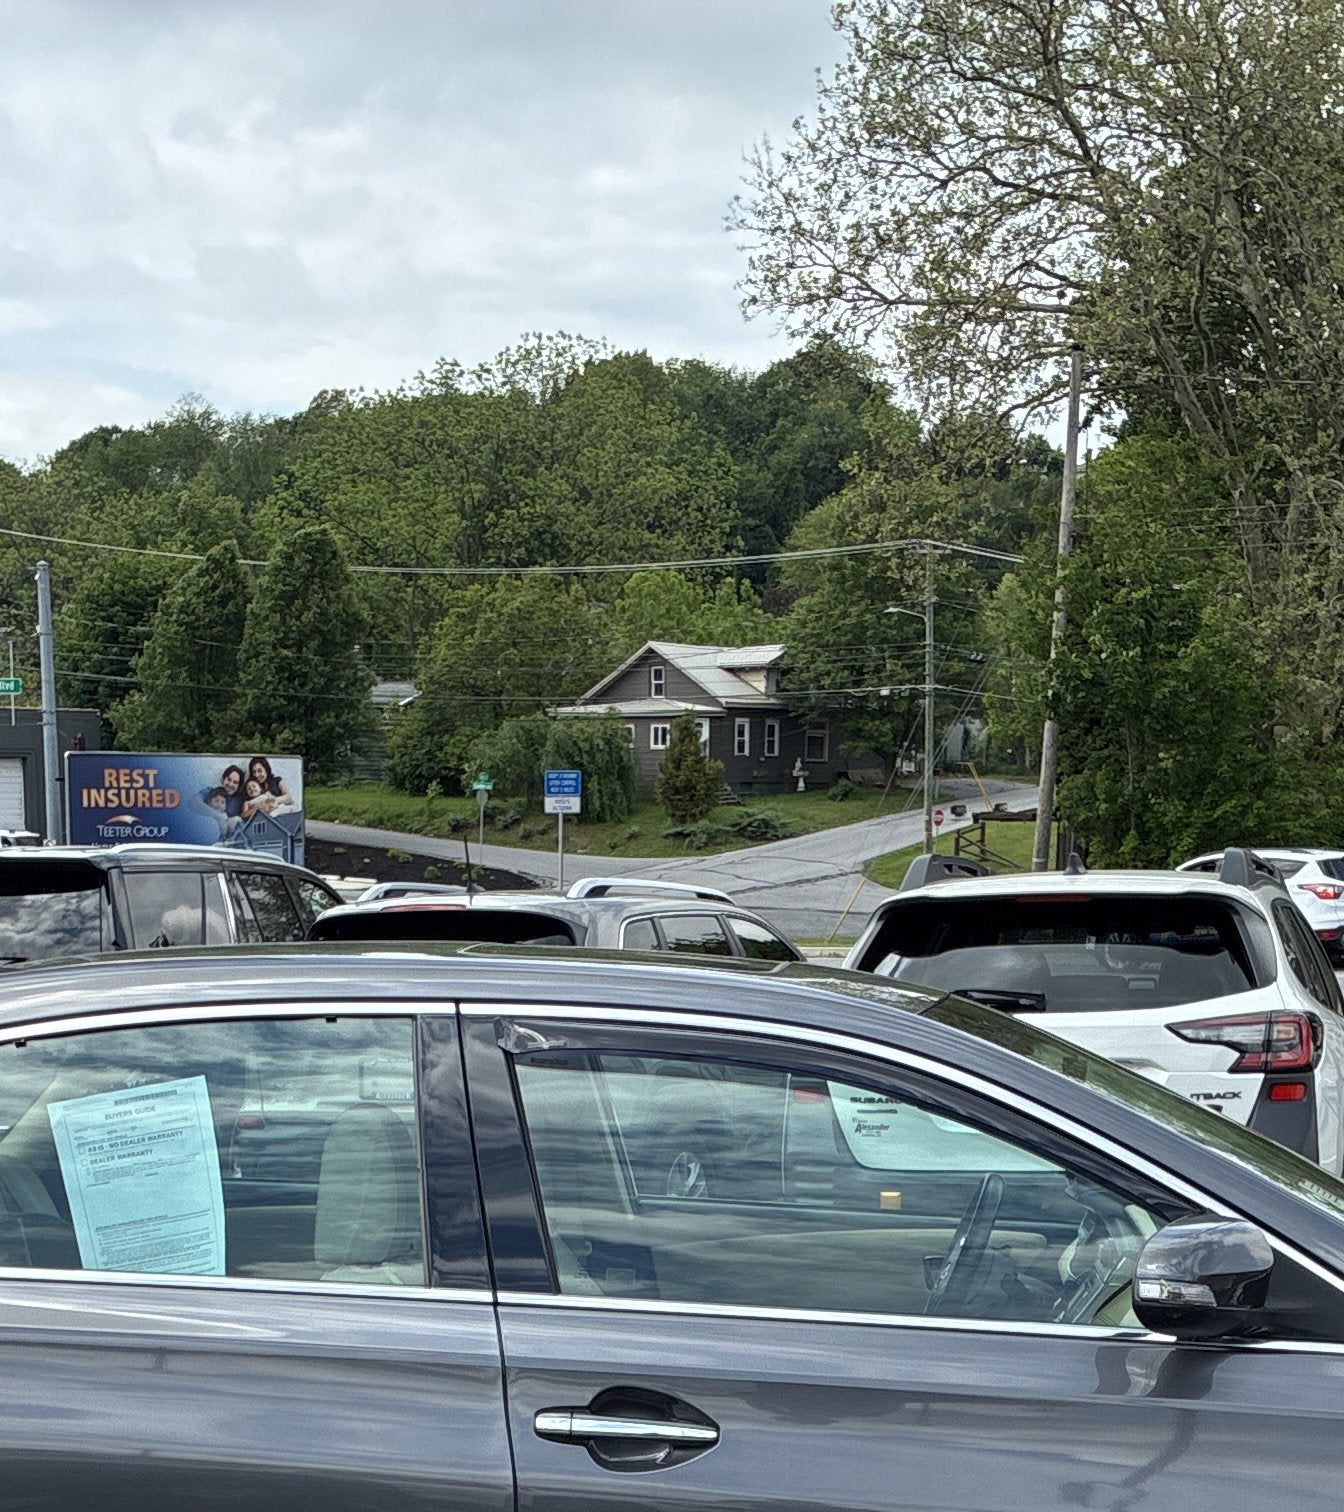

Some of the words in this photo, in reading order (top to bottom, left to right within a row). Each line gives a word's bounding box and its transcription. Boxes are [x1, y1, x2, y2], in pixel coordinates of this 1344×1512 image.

[103, 768, 158, 788] REST
[82, 788, 181, 808] INSURED
[96, 824, 132, 838] TEETER
[133, 824, 169, 838] GROUP
[104, 1110, 133, 1120] BUYERS
[855, 1123, 890, 1134] Alexander
[120, 1137, 146, 1147] DEALER
[147, 1130, 184, 1142] WARRANTY
[89, 1155, 116, 1165] DEALER
[117, 1149, 154, 1160] WARRANTY
